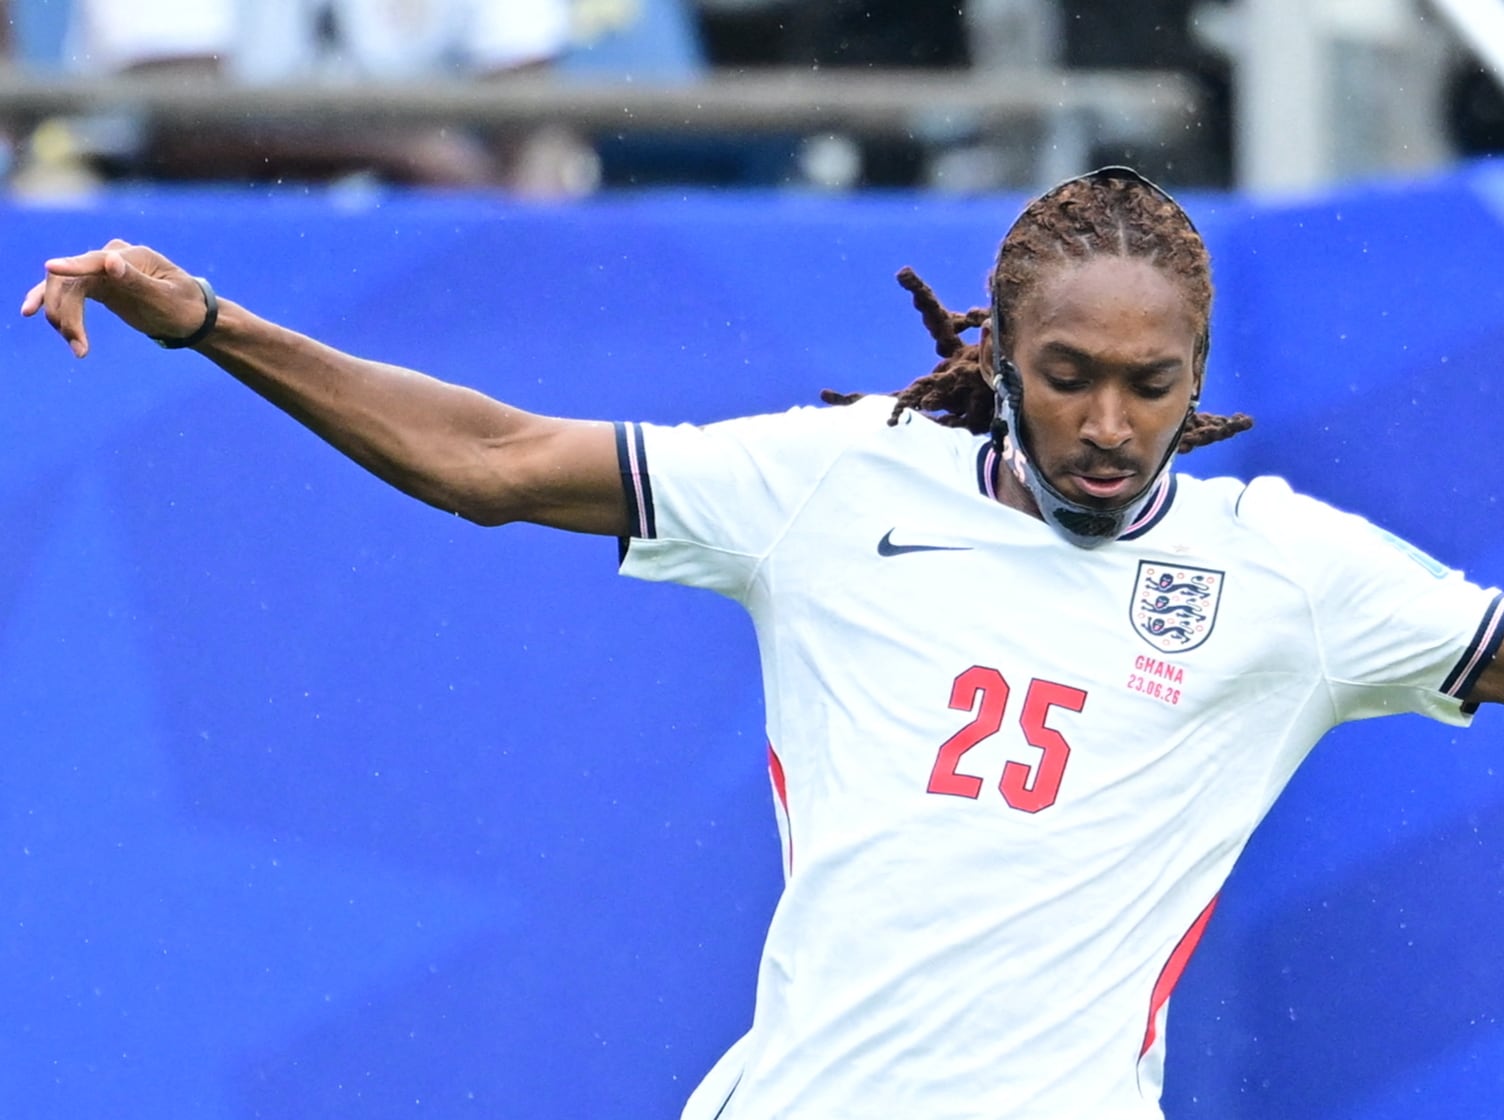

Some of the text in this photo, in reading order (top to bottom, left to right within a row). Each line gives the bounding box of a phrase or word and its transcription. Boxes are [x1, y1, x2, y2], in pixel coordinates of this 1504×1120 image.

[1135, 655, 1184, 684] GHANA
[1127, 674, 1180, 705] 23.06.26
[926, 665, 1088, 814] 25
